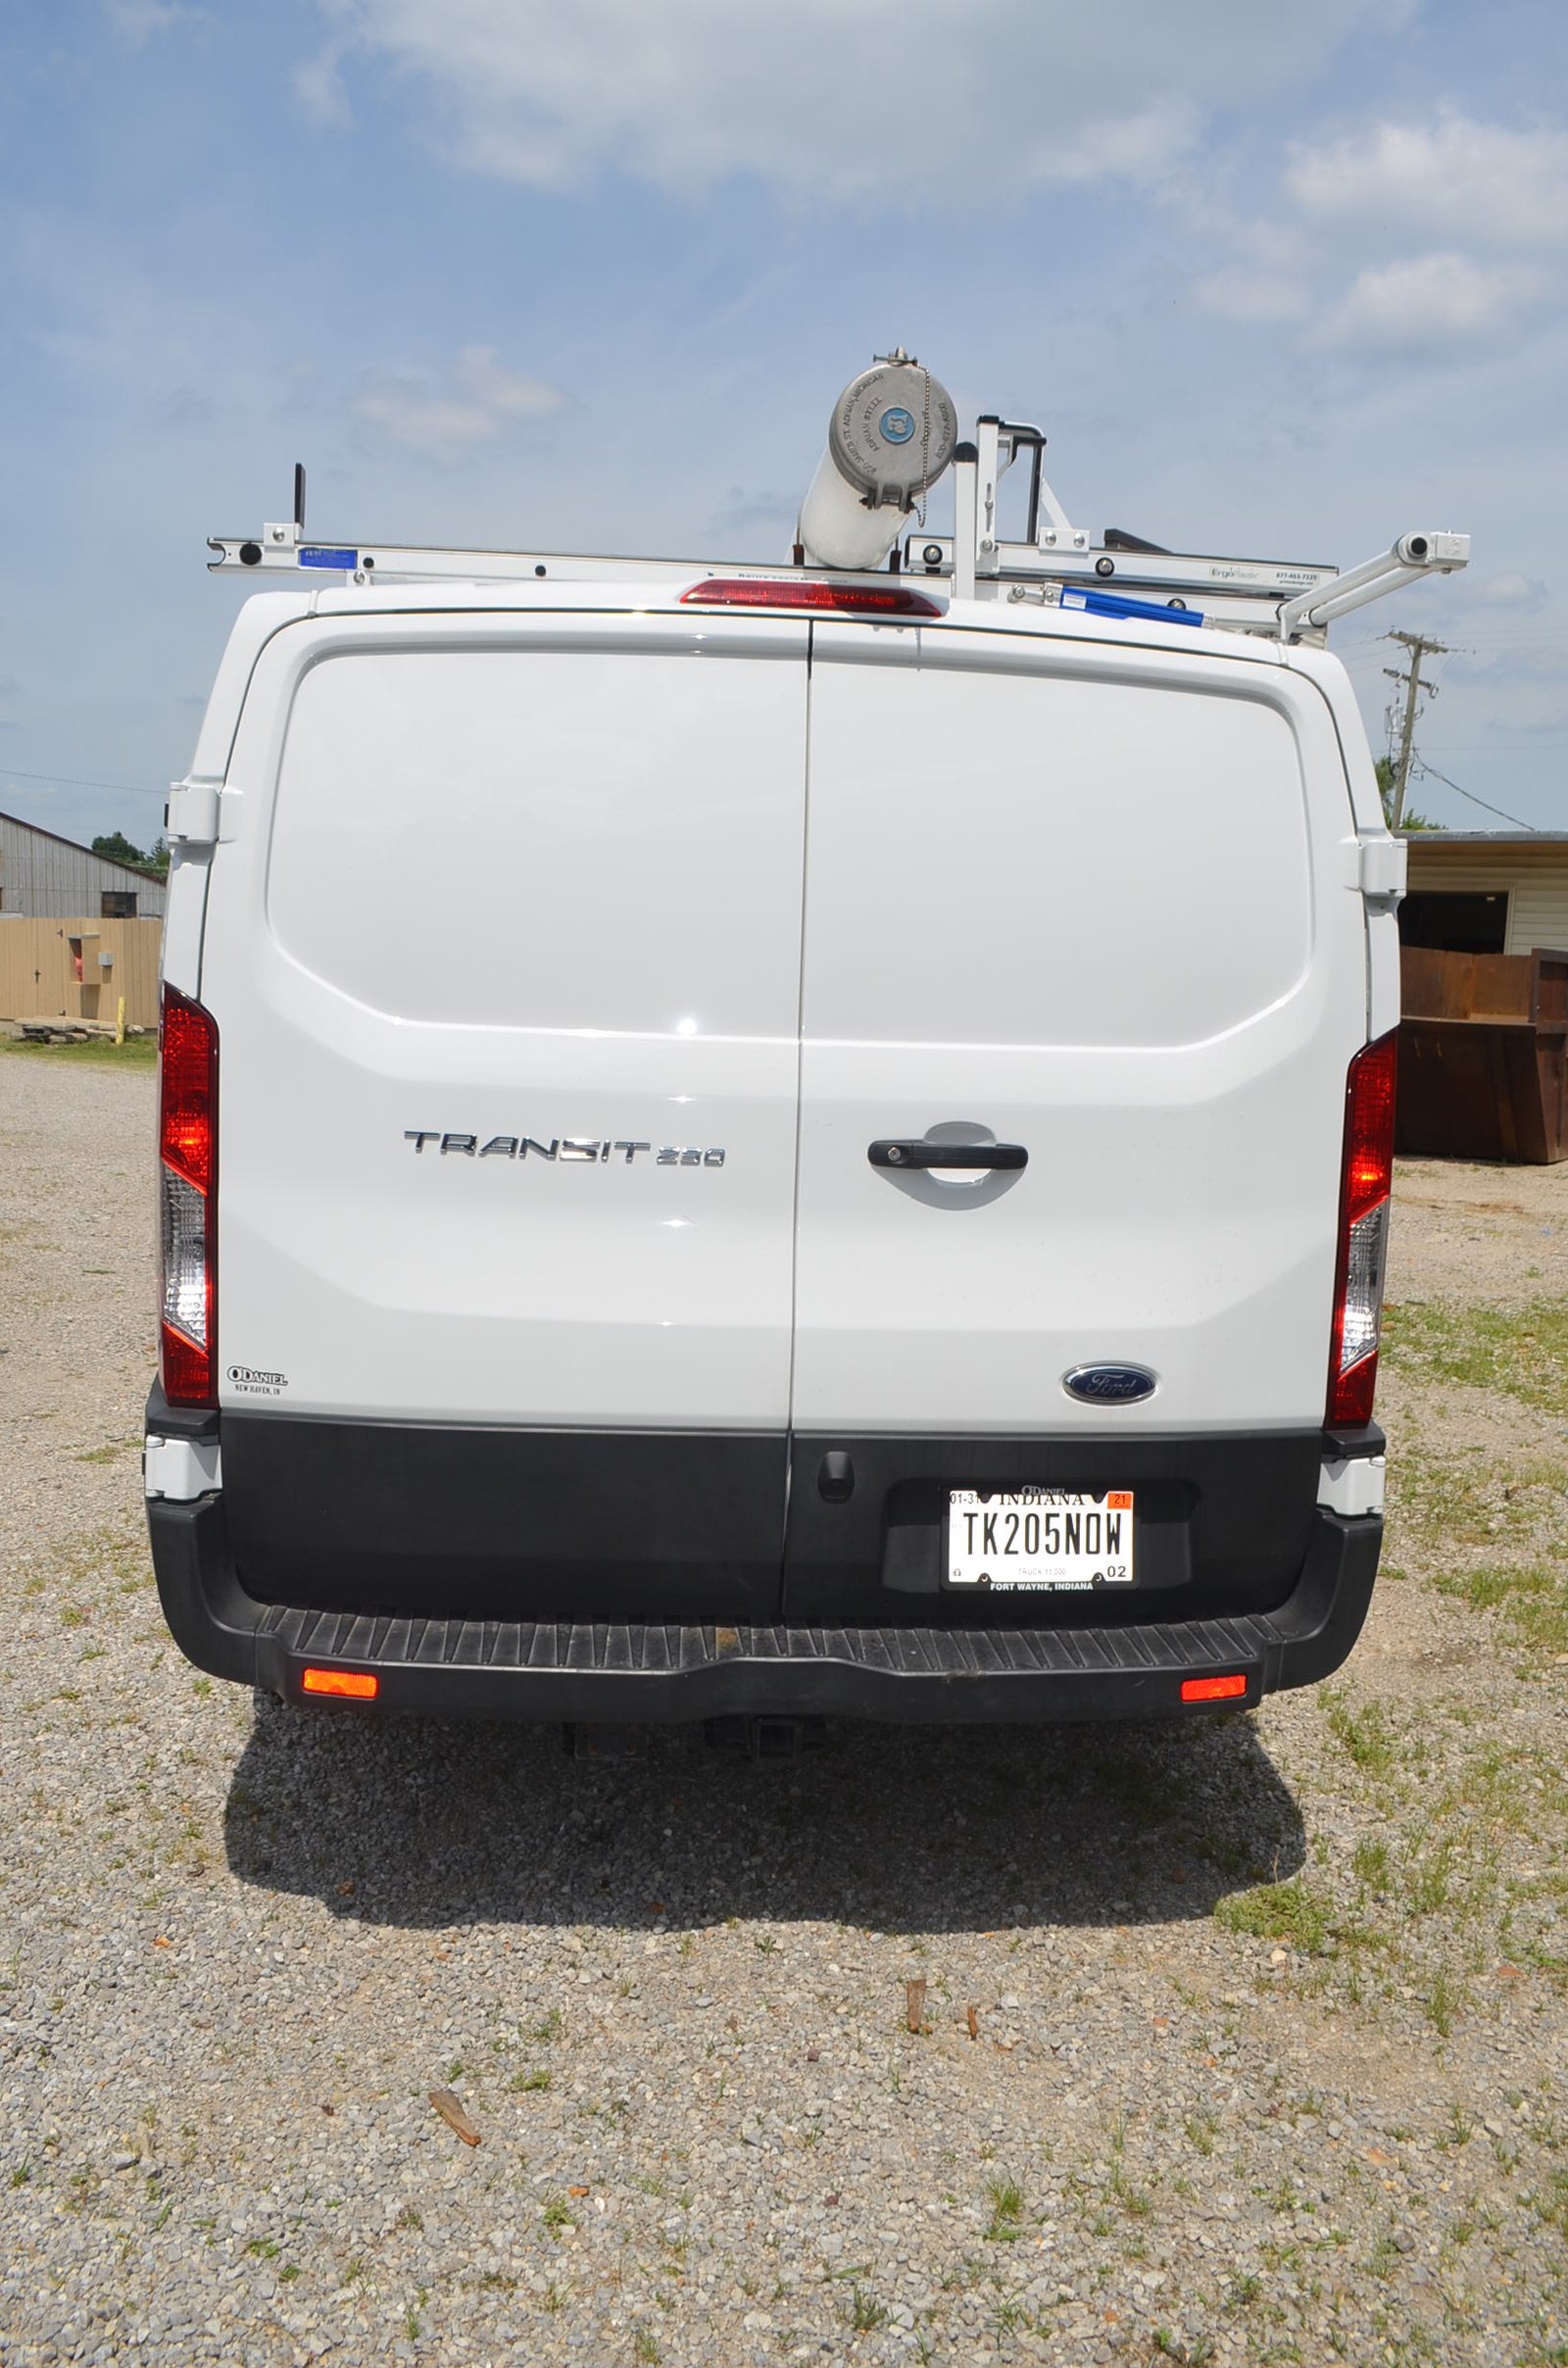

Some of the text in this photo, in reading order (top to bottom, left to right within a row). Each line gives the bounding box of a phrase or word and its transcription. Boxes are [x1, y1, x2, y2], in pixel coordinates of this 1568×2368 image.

[404, 1130, 651, 1164] TRANSIT
[1086, 1373, 1137, 1395] Ford
[999, 1492, 1086, 1506] INDIANA
[1113, 1494, 1127, 1505] 21
[963, 1512, 1122, 1555] TK205NOW
[1106, 1565, 1127, 1578] 02
[990, 1582, 1094, 1592] FORT WAYNE, INDIANA
